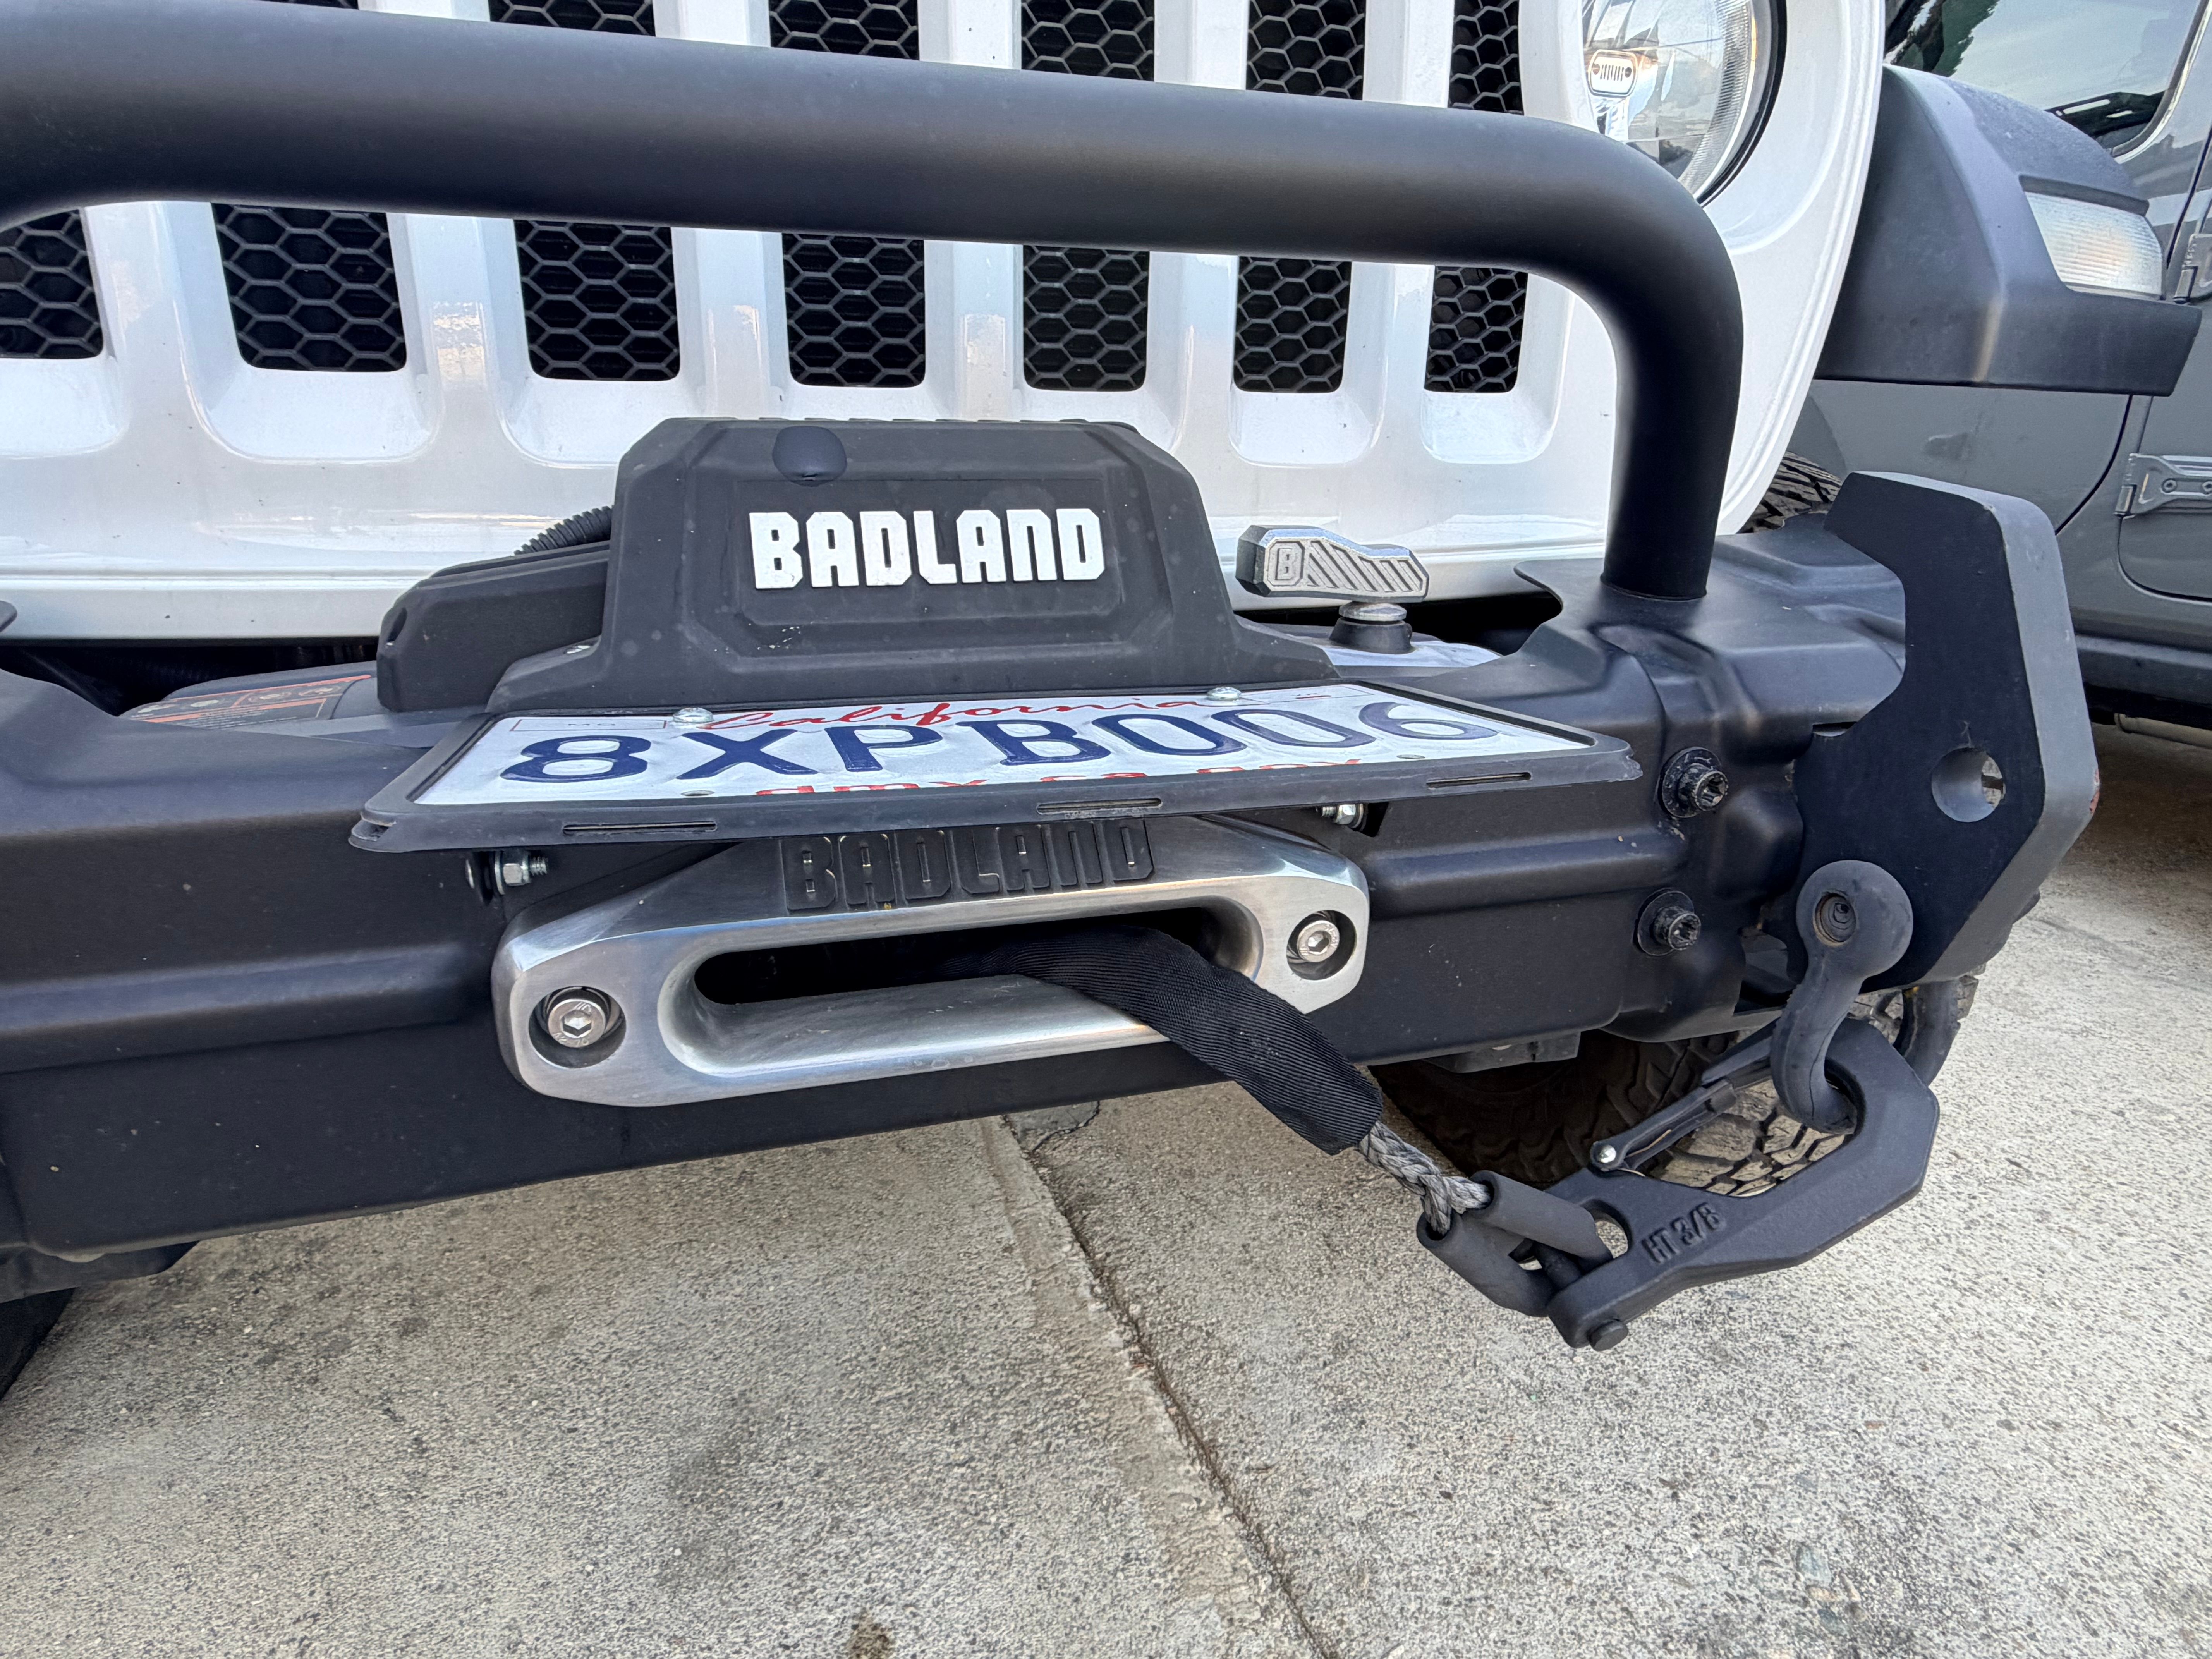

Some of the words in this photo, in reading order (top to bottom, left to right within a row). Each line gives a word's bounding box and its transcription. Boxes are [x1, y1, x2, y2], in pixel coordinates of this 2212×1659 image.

[749, 508, 1105, 589] BADLAND
[501, 701, 1499, 783] 8XPB006
[696, 697, 1270, 730] California
[779, 819, 1155, 912] BADLAND
